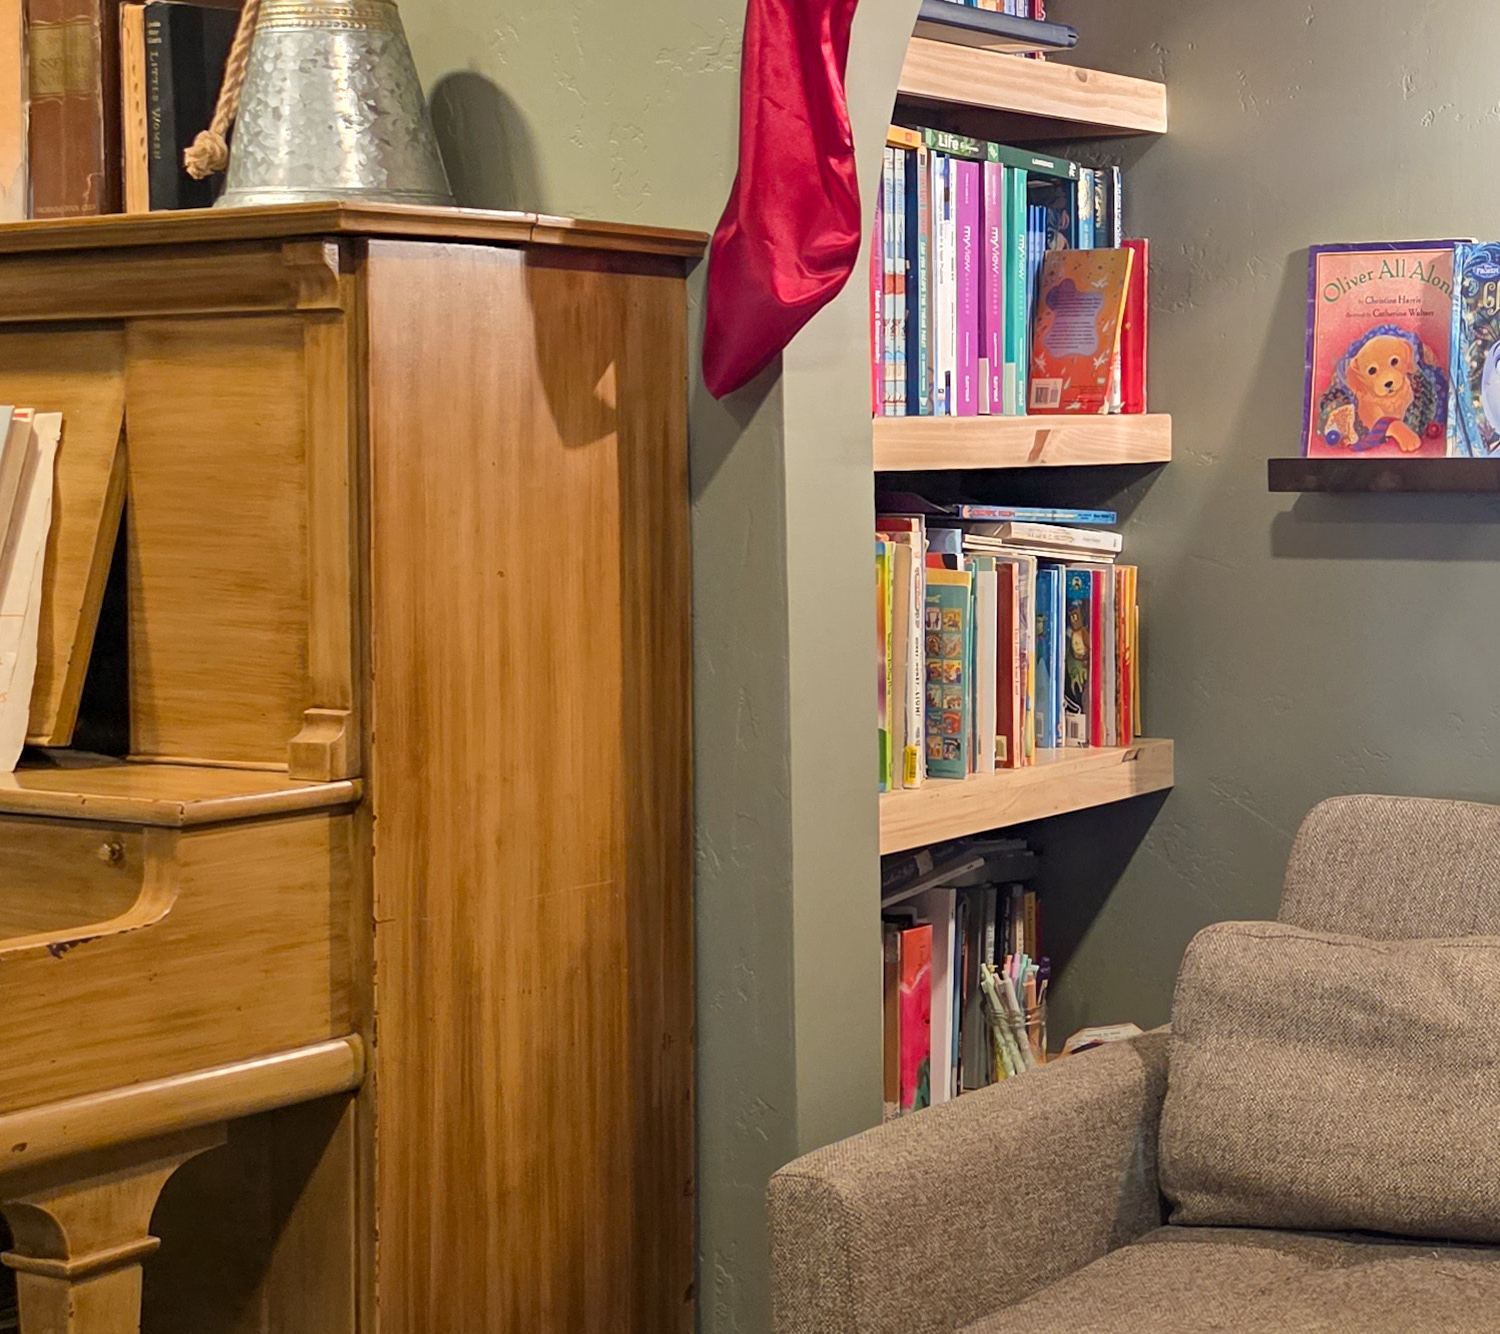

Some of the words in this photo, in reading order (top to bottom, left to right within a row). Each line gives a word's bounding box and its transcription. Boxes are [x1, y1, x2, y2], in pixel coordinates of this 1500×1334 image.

[149, 50, 159, 102] LITTLE
[152, 107, 162, 160] WOMEN
[938, 134, 959, 151] Life
[1323, 270, 1374, 302] Oliver
[1378, 258, 1406, 279] All
